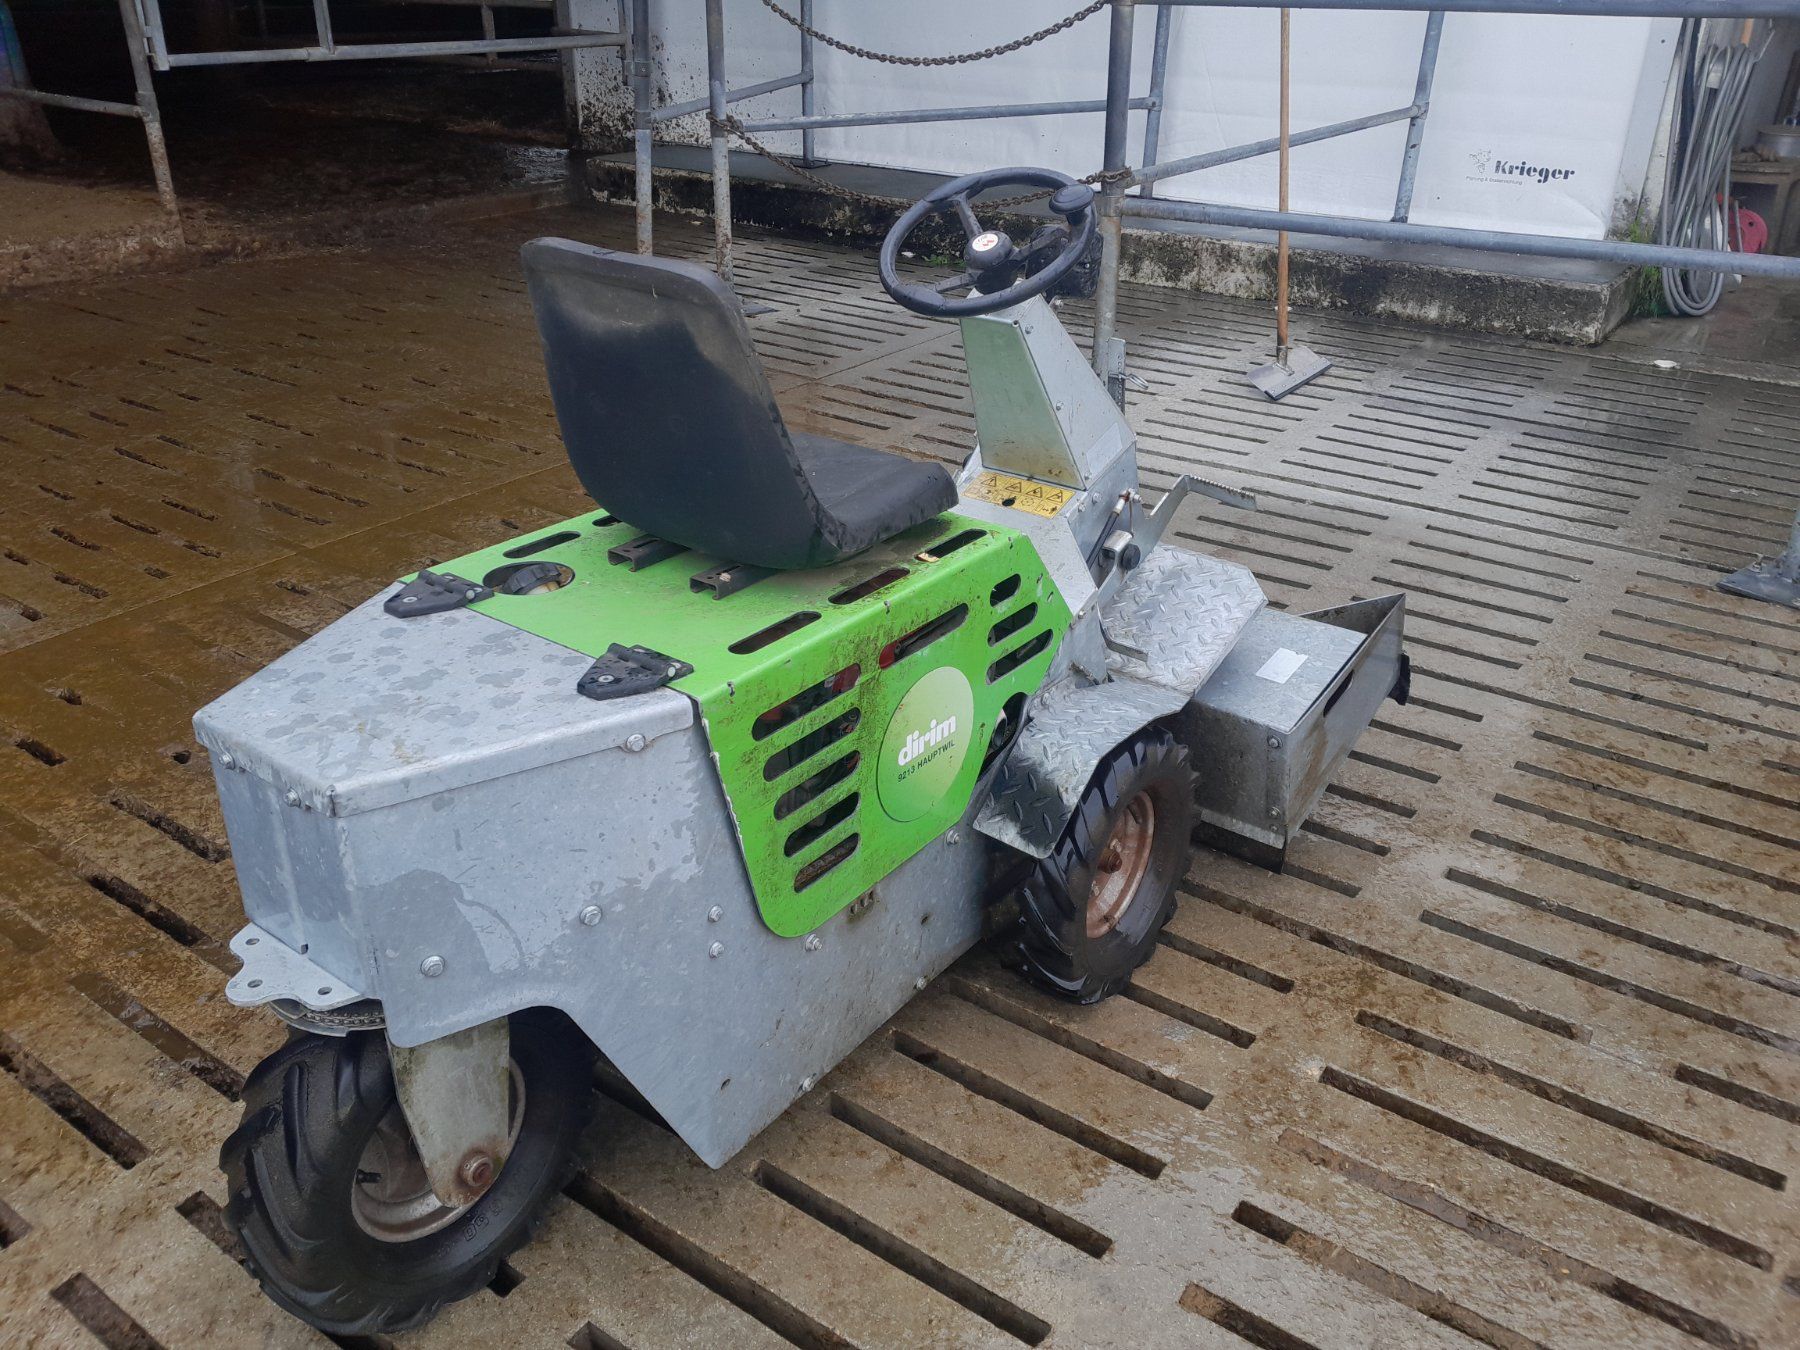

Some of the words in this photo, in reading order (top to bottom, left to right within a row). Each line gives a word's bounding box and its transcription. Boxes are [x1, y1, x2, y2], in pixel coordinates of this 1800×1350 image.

[1494, 160, 1575, 184] Krieger
[897, 765, 916, 783] 9213
[917, 739, 955, 770] HAUPTWIL
[898, 715, 957, 767] dirim
